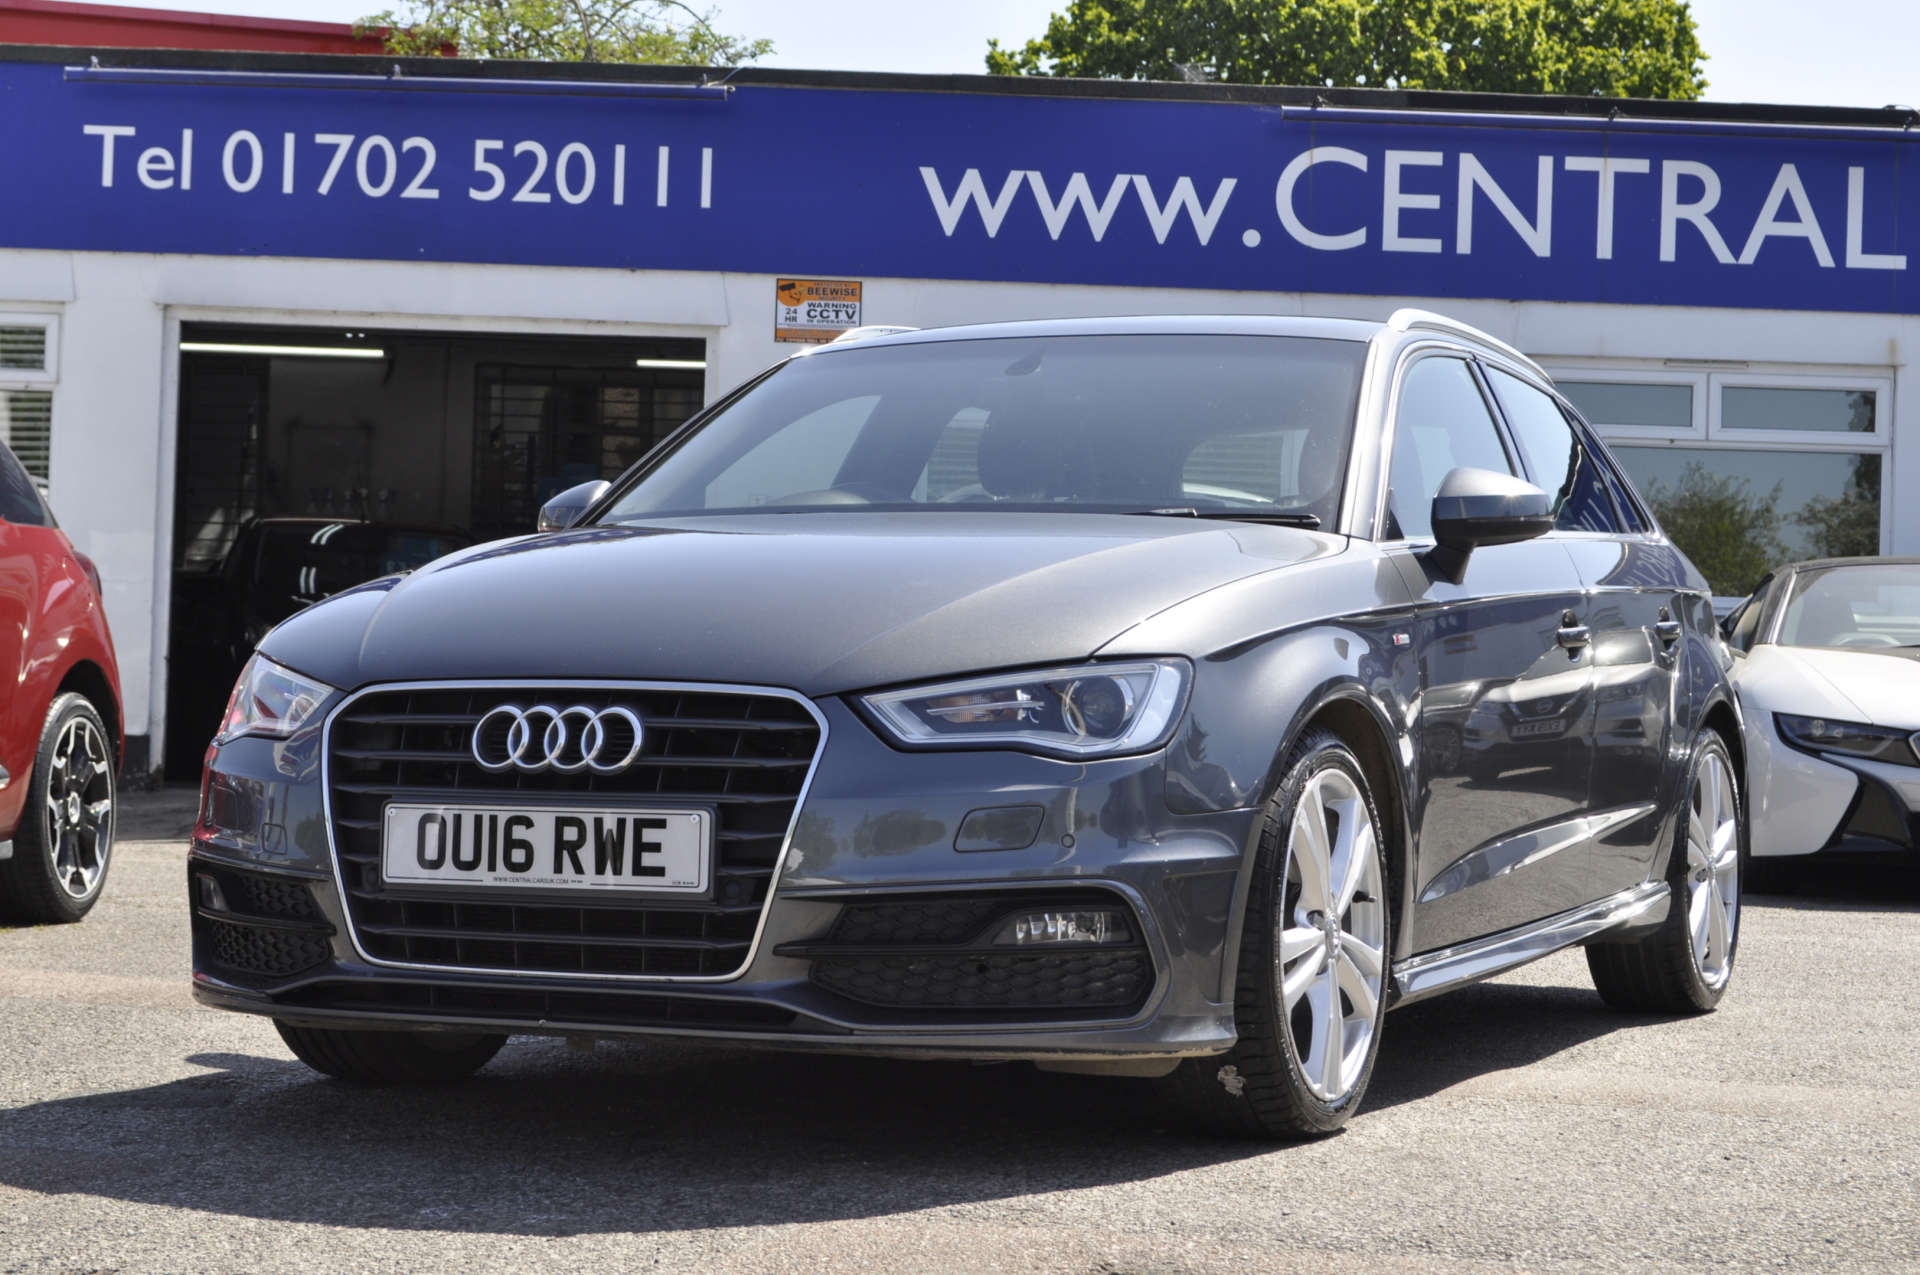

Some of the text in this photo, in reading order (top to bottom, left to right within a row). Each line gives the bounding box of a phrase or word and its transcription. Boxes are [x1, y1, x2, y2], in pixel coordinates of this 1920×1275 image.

[83, 125, 713, 209] Tel 01702 520111
[919, 146, 1907, 270] www.CENTRAL
[807, 287, 857, 296] BEEWISE
[785, 315, 798, 323] HR
[806, 308, 857, 320] CCTV
[416, 812, 668, 878] OU16 RWE
